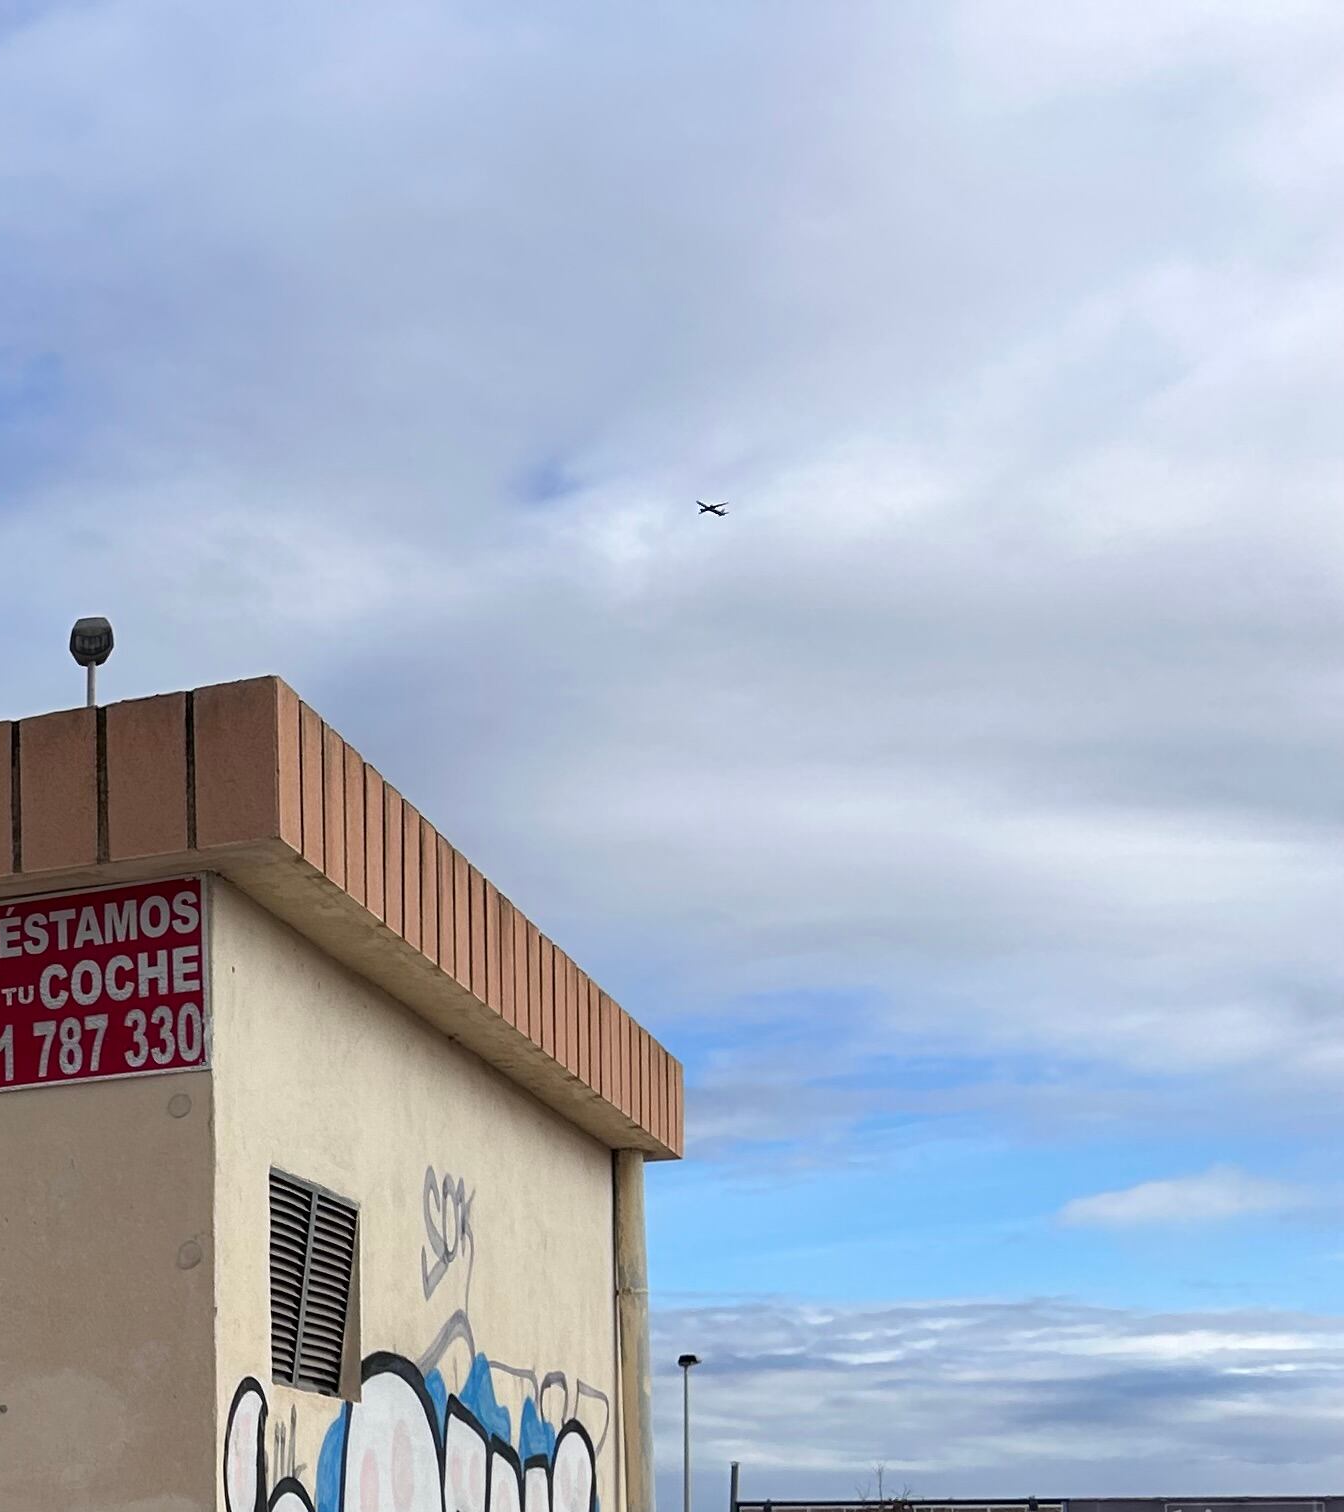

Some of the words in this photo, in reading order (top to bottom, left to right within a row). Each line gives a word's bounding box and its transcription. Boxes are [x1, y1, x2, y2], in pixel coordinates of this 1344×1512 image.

[1, 984, 35, 1006] TU
[39, 945, 201, 1010] COCHE
[33, 1013, 109, 1078] 787
[124, 1002, 203, 1068] 330
